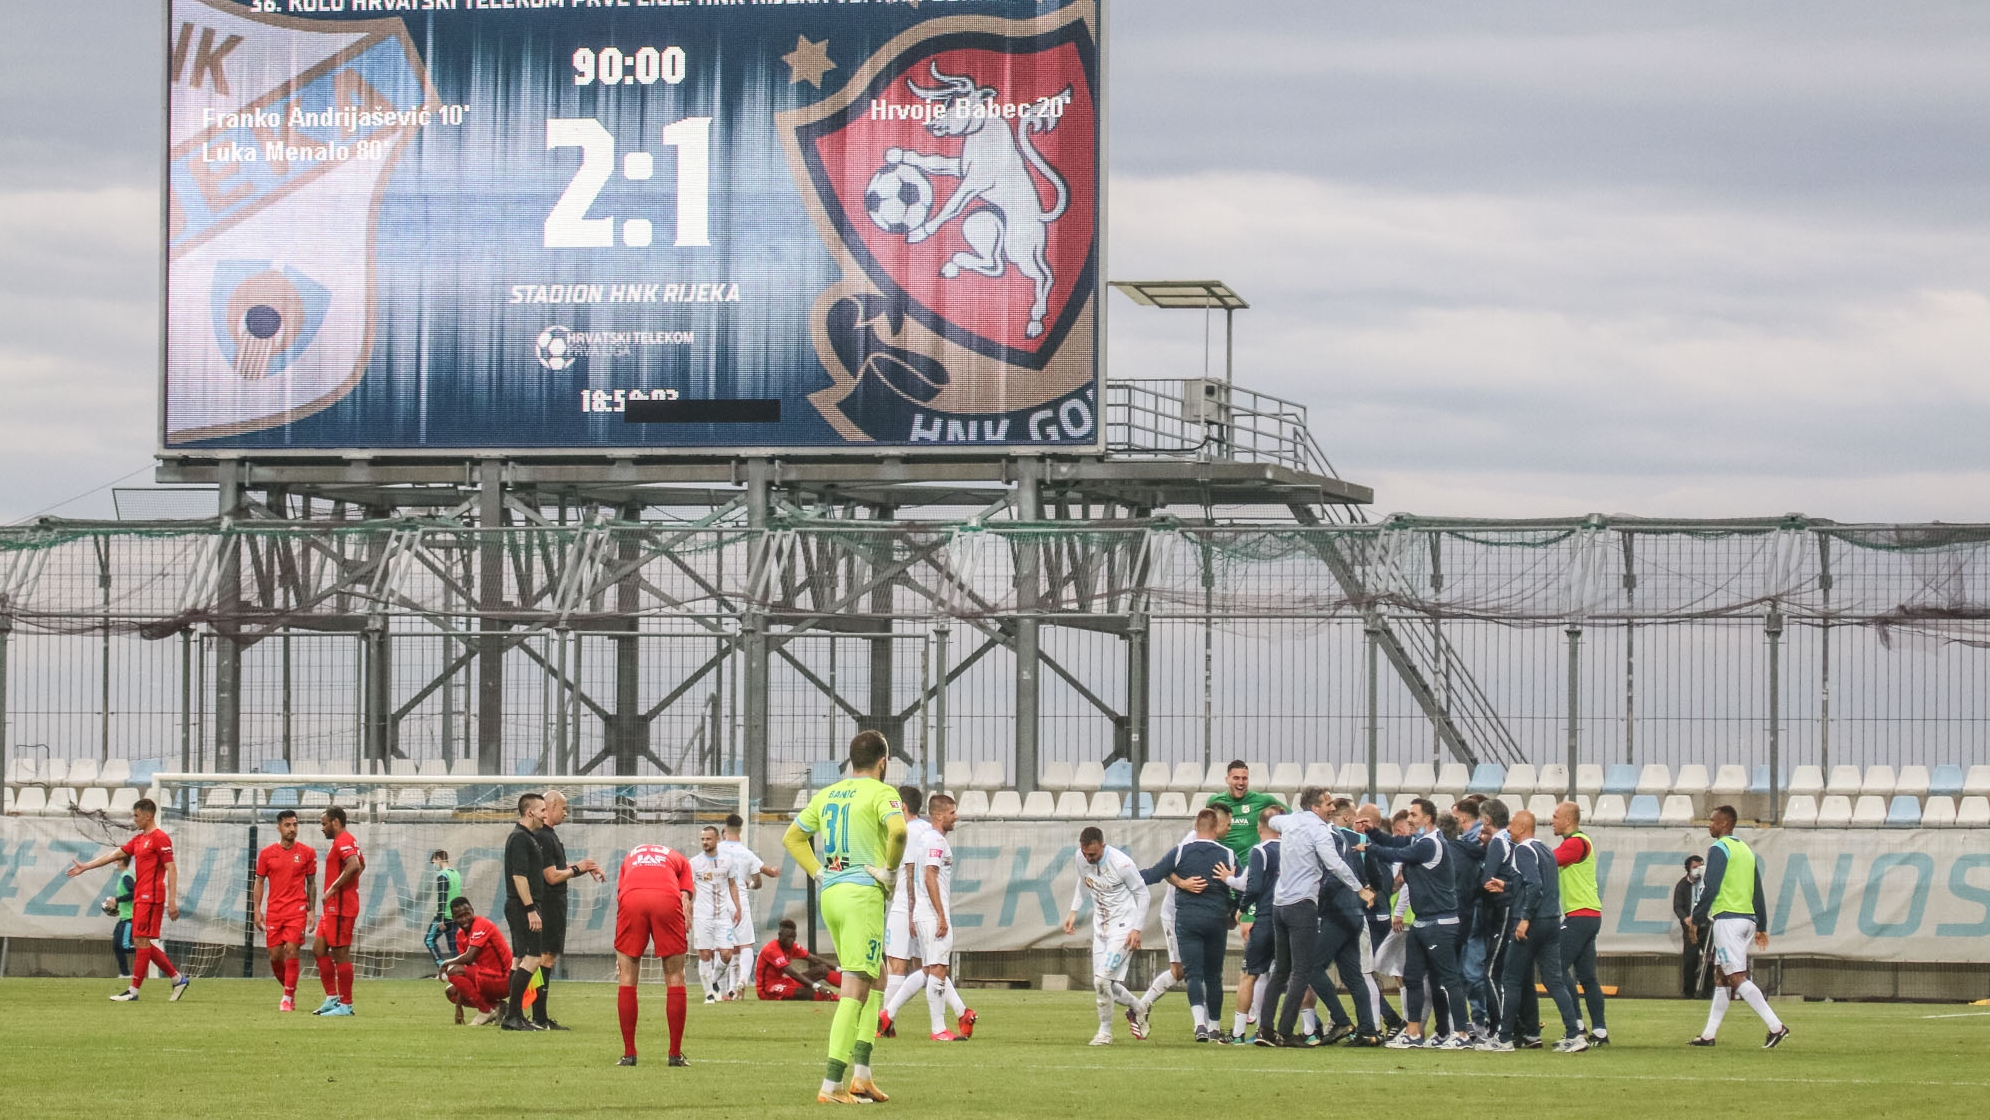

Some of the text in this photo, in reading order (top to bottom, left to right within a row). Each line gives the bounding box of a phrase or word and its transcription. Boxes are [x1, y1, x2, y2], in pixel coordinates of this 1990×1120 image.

[573, 46, 686, 86] 90:00
[202, 107, 281, 128] Franko
[288, 105, 432, 131] Andrijašević
[870, 98, 946, 126] Hrvoje
[955, 97, 1030, 120] Babec
[202, 141, 257, 163] Luka
[265, 140, 349, 162] Menalo
[543, 116, 713, 248] 2:1
[508, 282, 740, 303] STADION HNK RIJEKA
[566, 330, 695, 345] HRVATSKI TELEKOM
[828, 789, 857, 799] BANIĆ
[821, 802, 851, 854] 31
